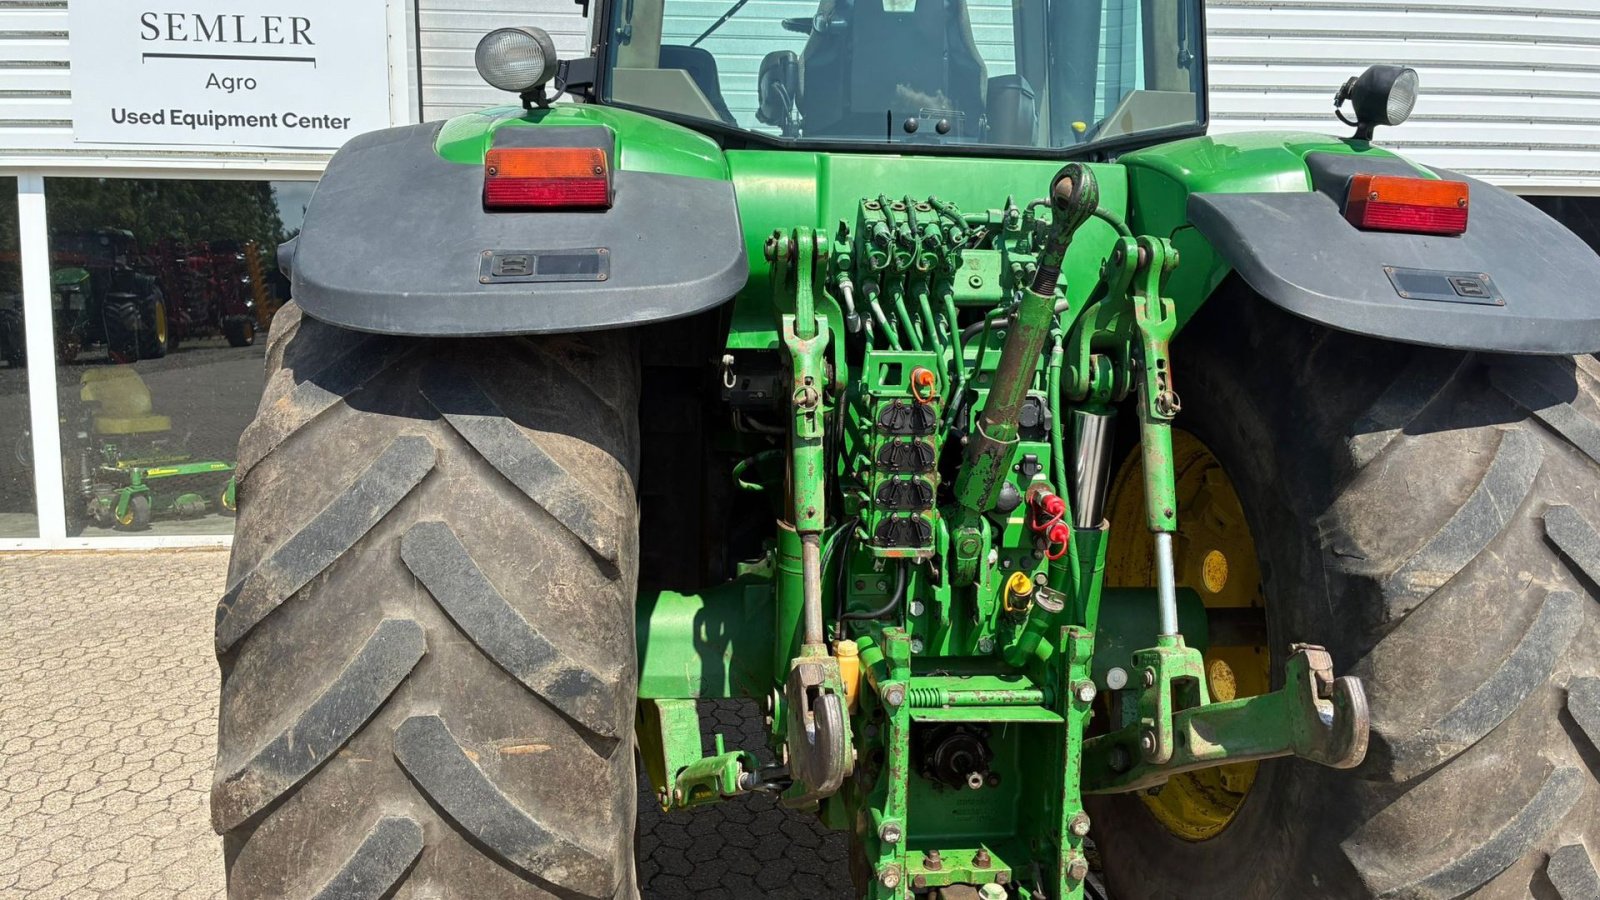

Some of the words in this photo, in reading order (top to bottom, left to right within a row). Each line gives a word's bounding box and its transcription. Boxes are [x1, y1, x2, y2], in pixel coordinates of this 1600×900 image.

[140, 12, 316, 46] SEMLER
[205, 72, 257, 93] Agro
[111, 107, 165, 125] Used
[170, 109, 278, 131] Equipment
[282, 112, 351, 130] Center
